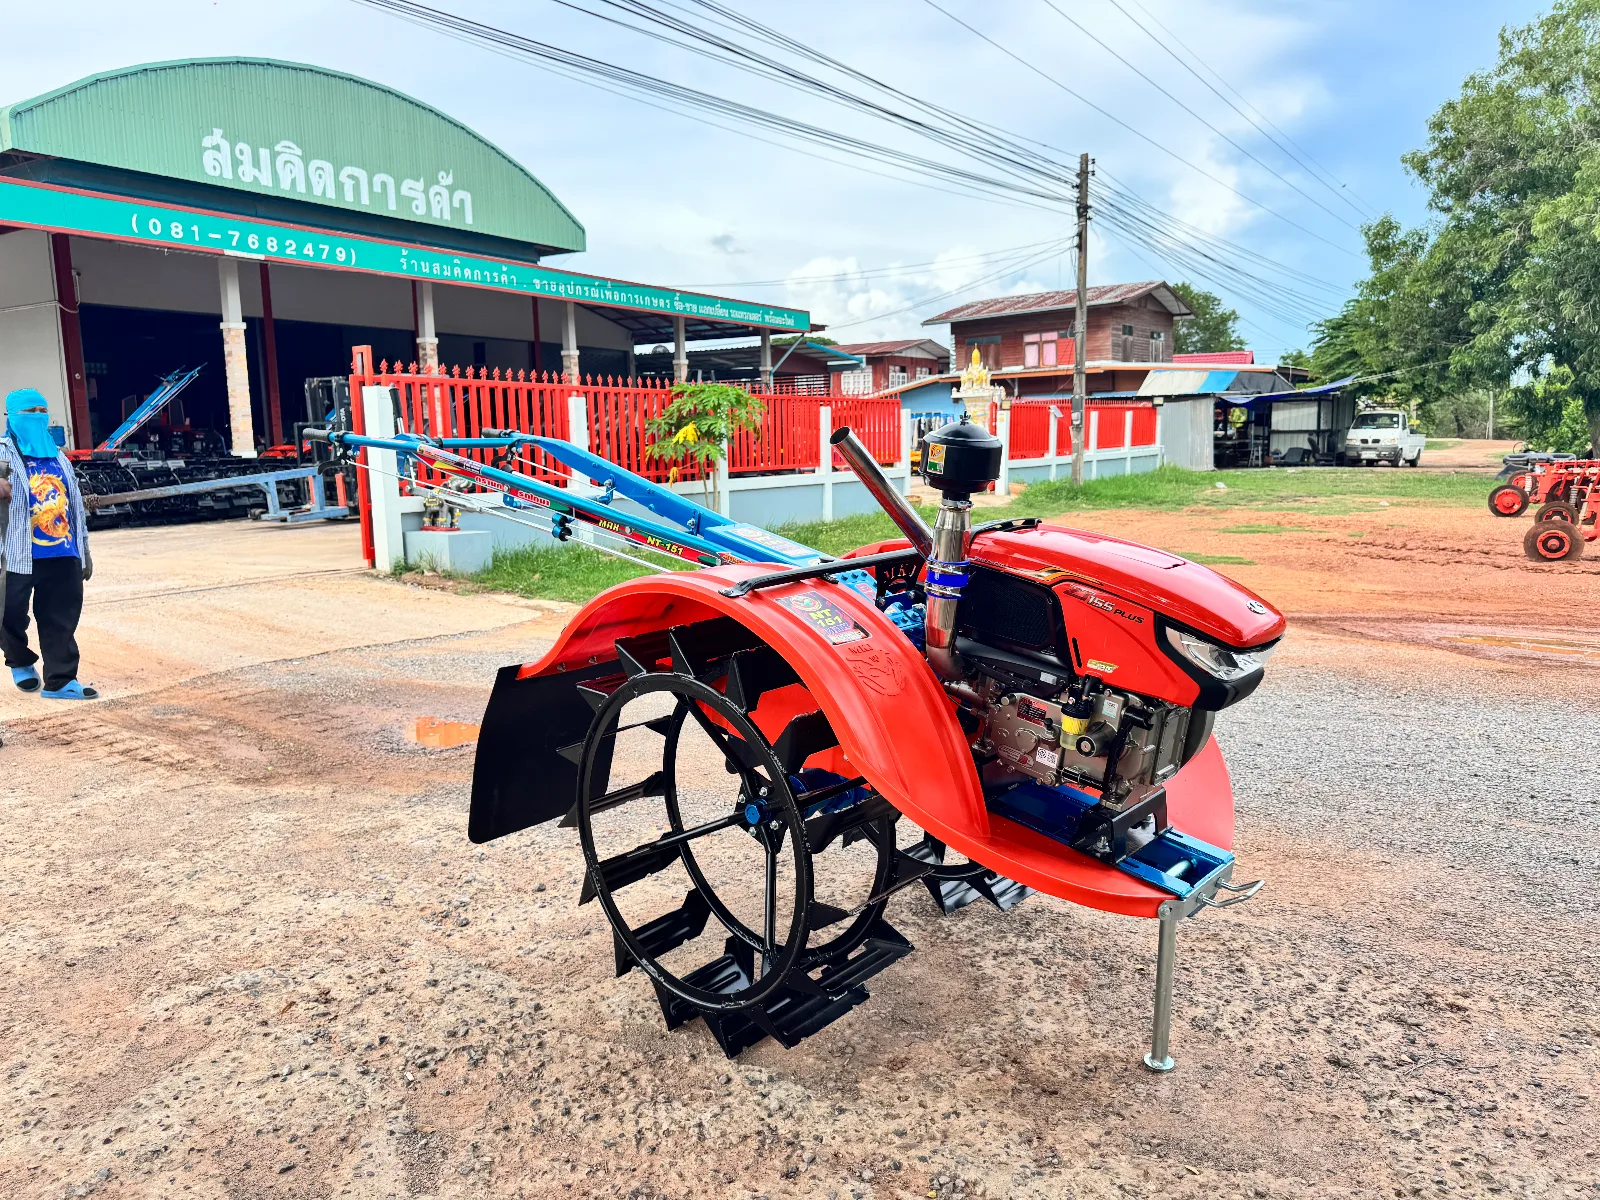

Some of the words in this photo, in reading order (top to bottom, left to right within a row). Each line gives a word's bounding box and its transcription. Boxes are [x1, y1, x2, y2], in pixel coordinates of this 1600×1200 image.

[202, 128, 474, 225] สมคิดการค้า
[131, 213, 357, 266] (081-7682479)
[399, 248, 517, 287] ร้านสมคิดการค้า
[646, 535, 684, 556] NT-151
[808, 608, 832, 620] NT
[816, 615, 843, 628] 151
[1113, 608, 1145, 624] PLUS
